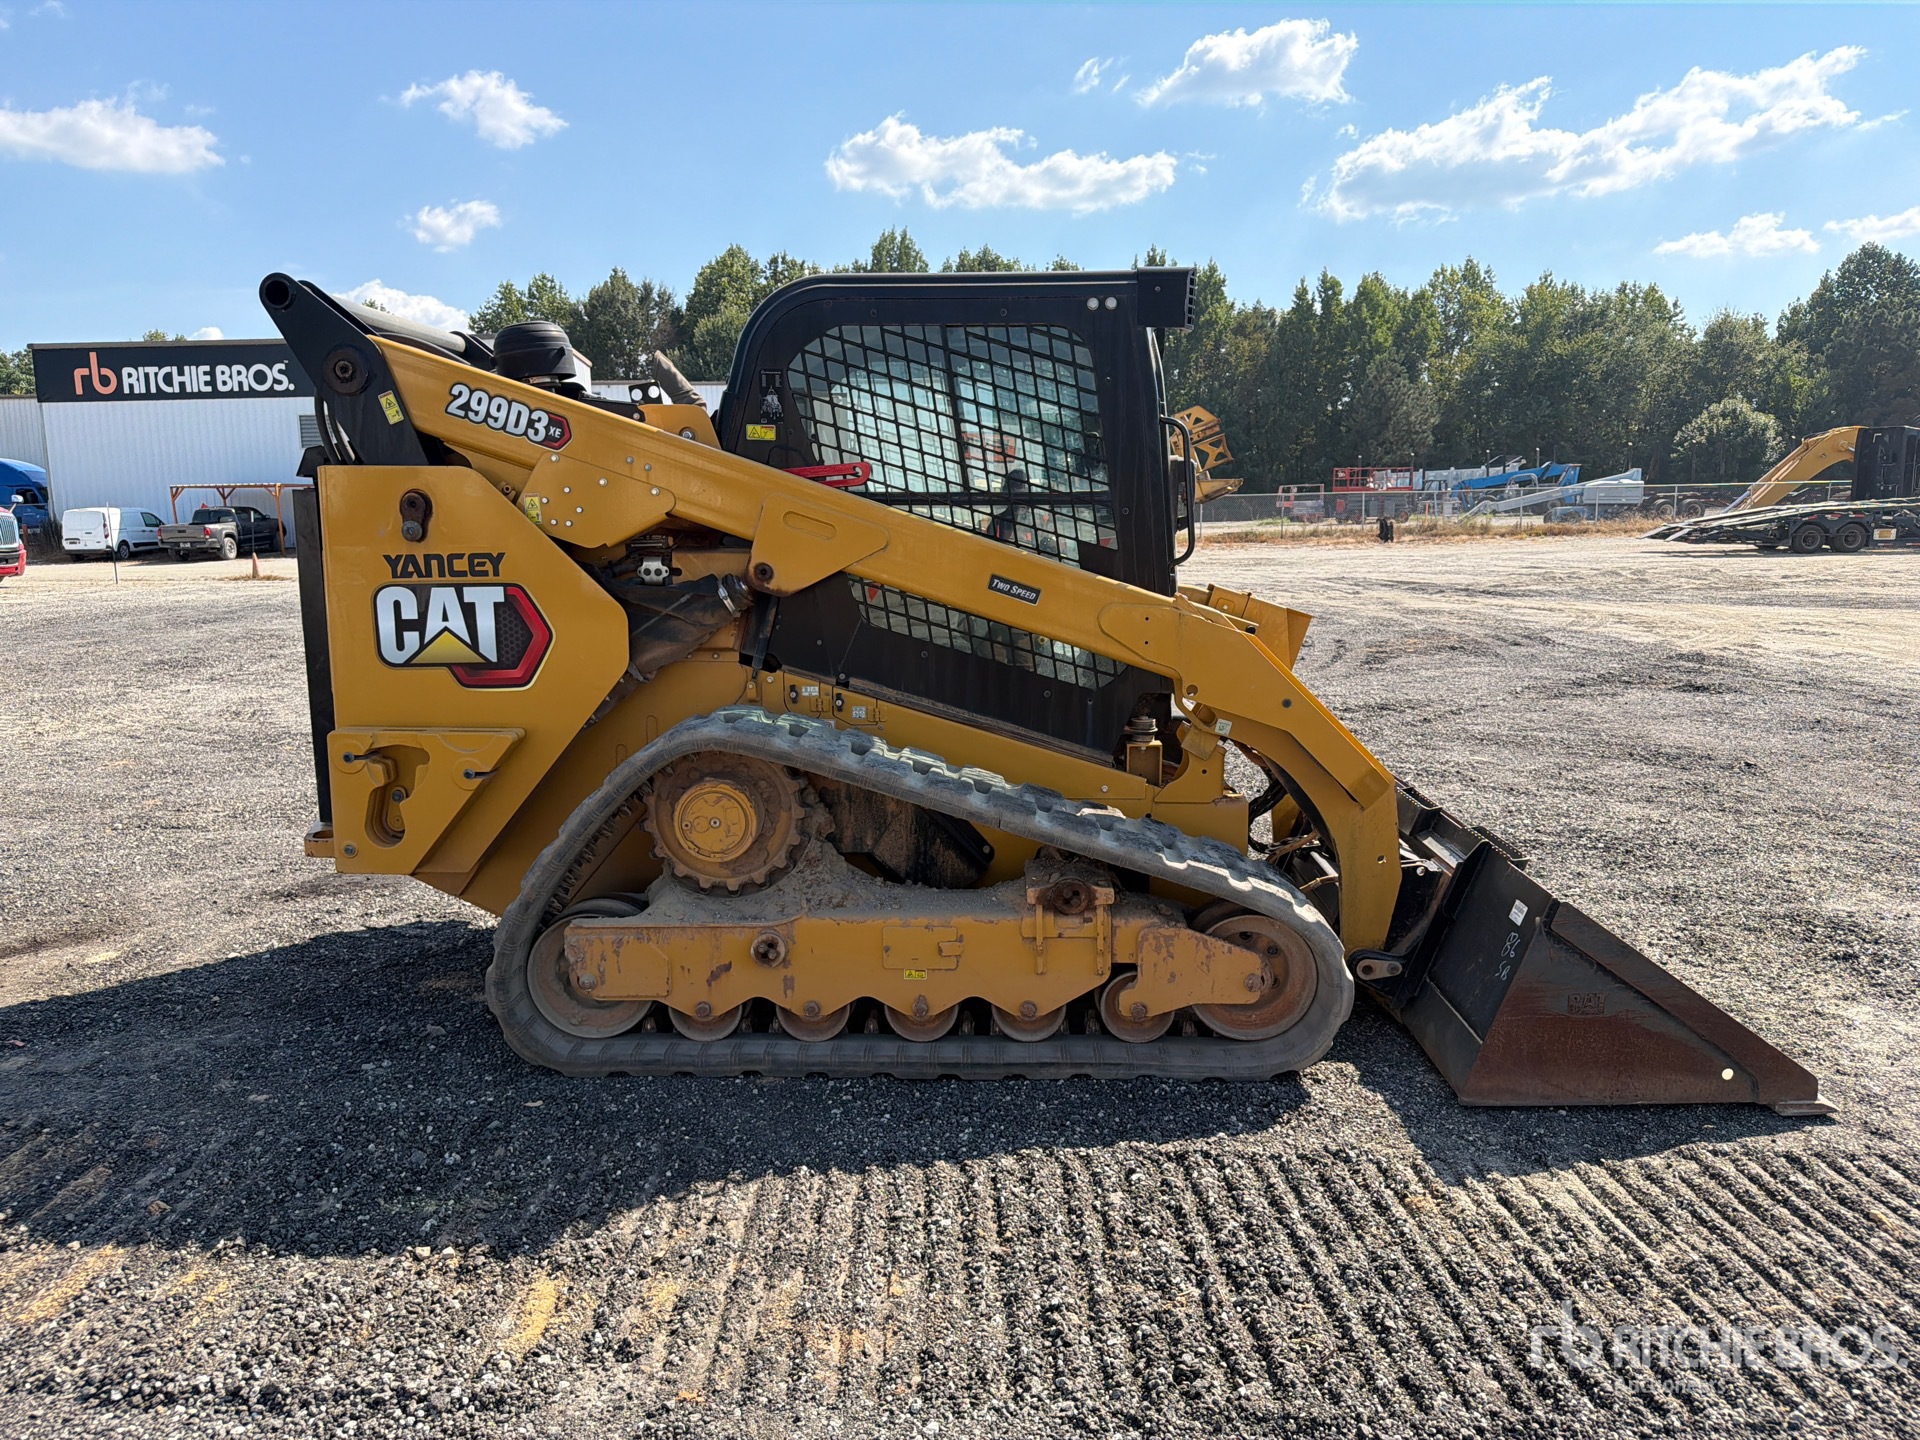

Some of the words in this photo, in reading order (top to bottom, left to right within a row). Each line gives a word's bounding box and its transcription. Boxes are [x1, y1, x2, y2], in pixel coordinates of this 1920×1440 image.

[122, 365, 212, 394] RITCHIE
[215, 363, 295, 392] BROS.
[445, 383, 549, 442] 299D3
[548, 425, 562, 438] XE
[382, 552, 506, 579] YANCEY
[376, 586, 505, 664] CAT
